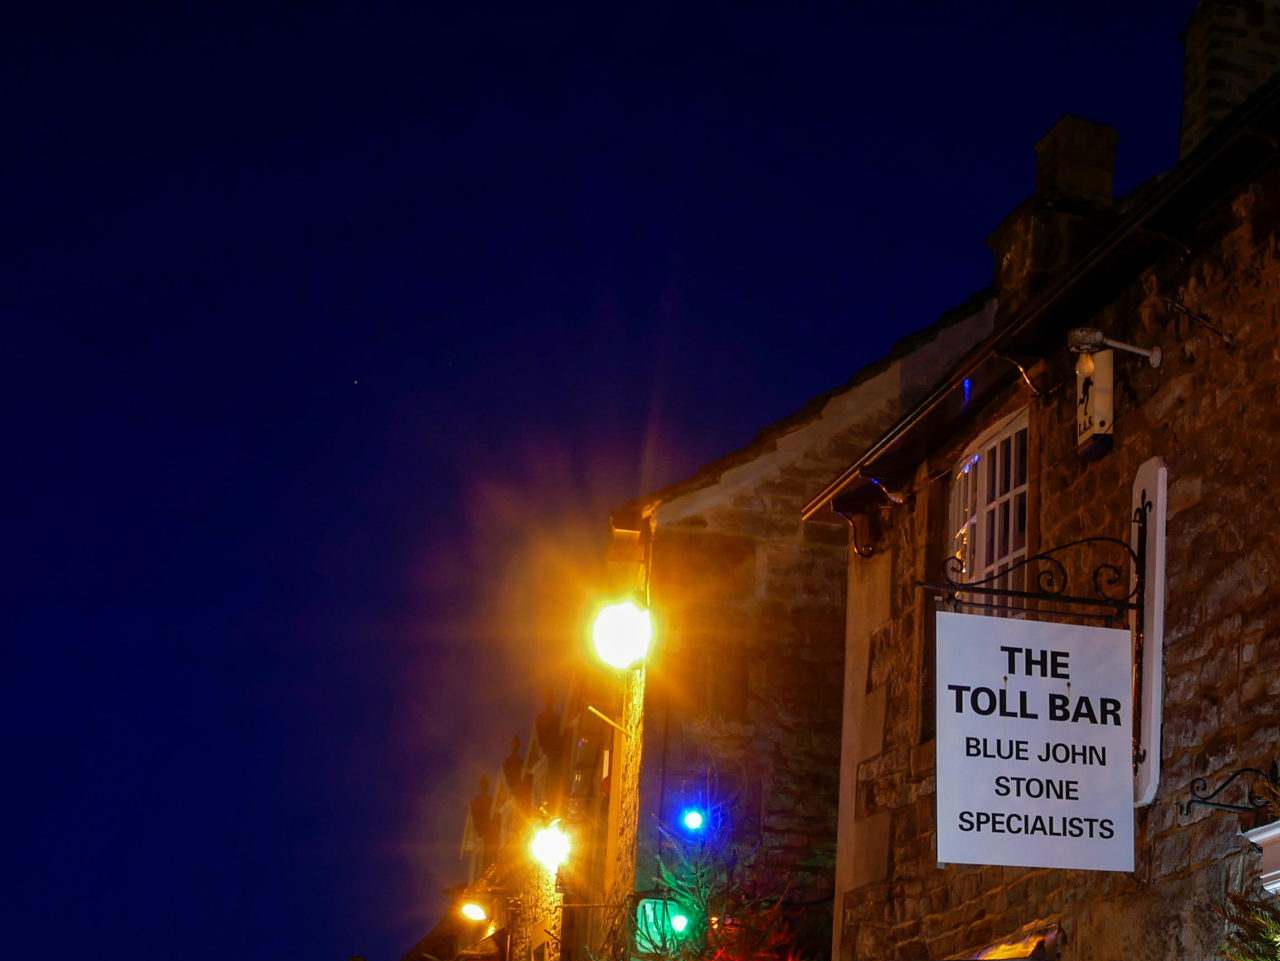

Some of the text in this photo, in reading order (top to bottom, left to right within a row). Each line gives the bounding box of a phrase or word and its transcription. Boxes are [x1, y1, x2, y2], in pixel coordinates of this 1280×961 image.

[1000, 645, 1070, 680] THE
[947, 684, 1122, 726] TOLL BAR
[965, 736, 1107, 766] BLUE JOHN
[994, 776, 1079, 801] STONE
[958, 810, 1115, 839] SPECIALISTS
